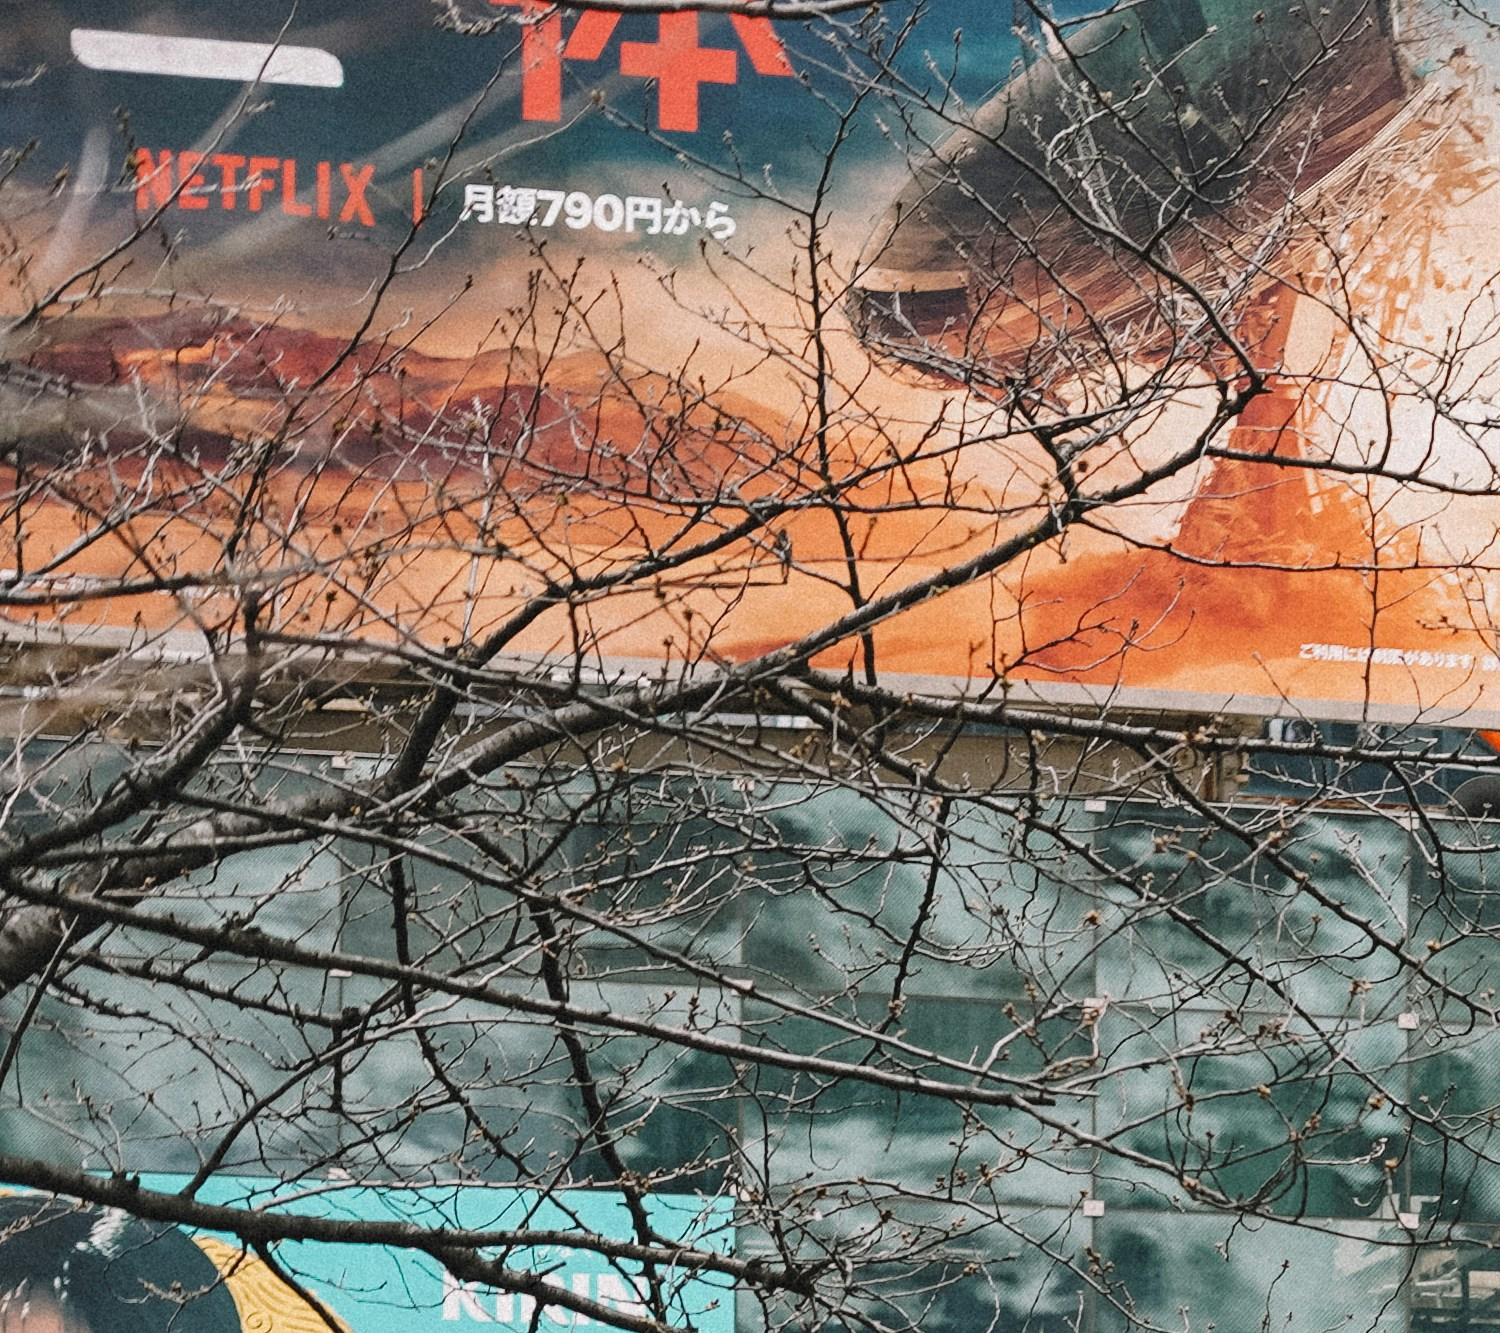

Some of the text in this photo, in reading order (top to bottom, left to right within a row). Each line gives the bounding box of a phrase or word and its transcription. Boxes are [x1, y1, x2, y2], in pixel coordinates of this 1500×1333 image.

[135, 147, 377, 228] NETFLIX
[460, 182, 738, 239] 月額790円から
